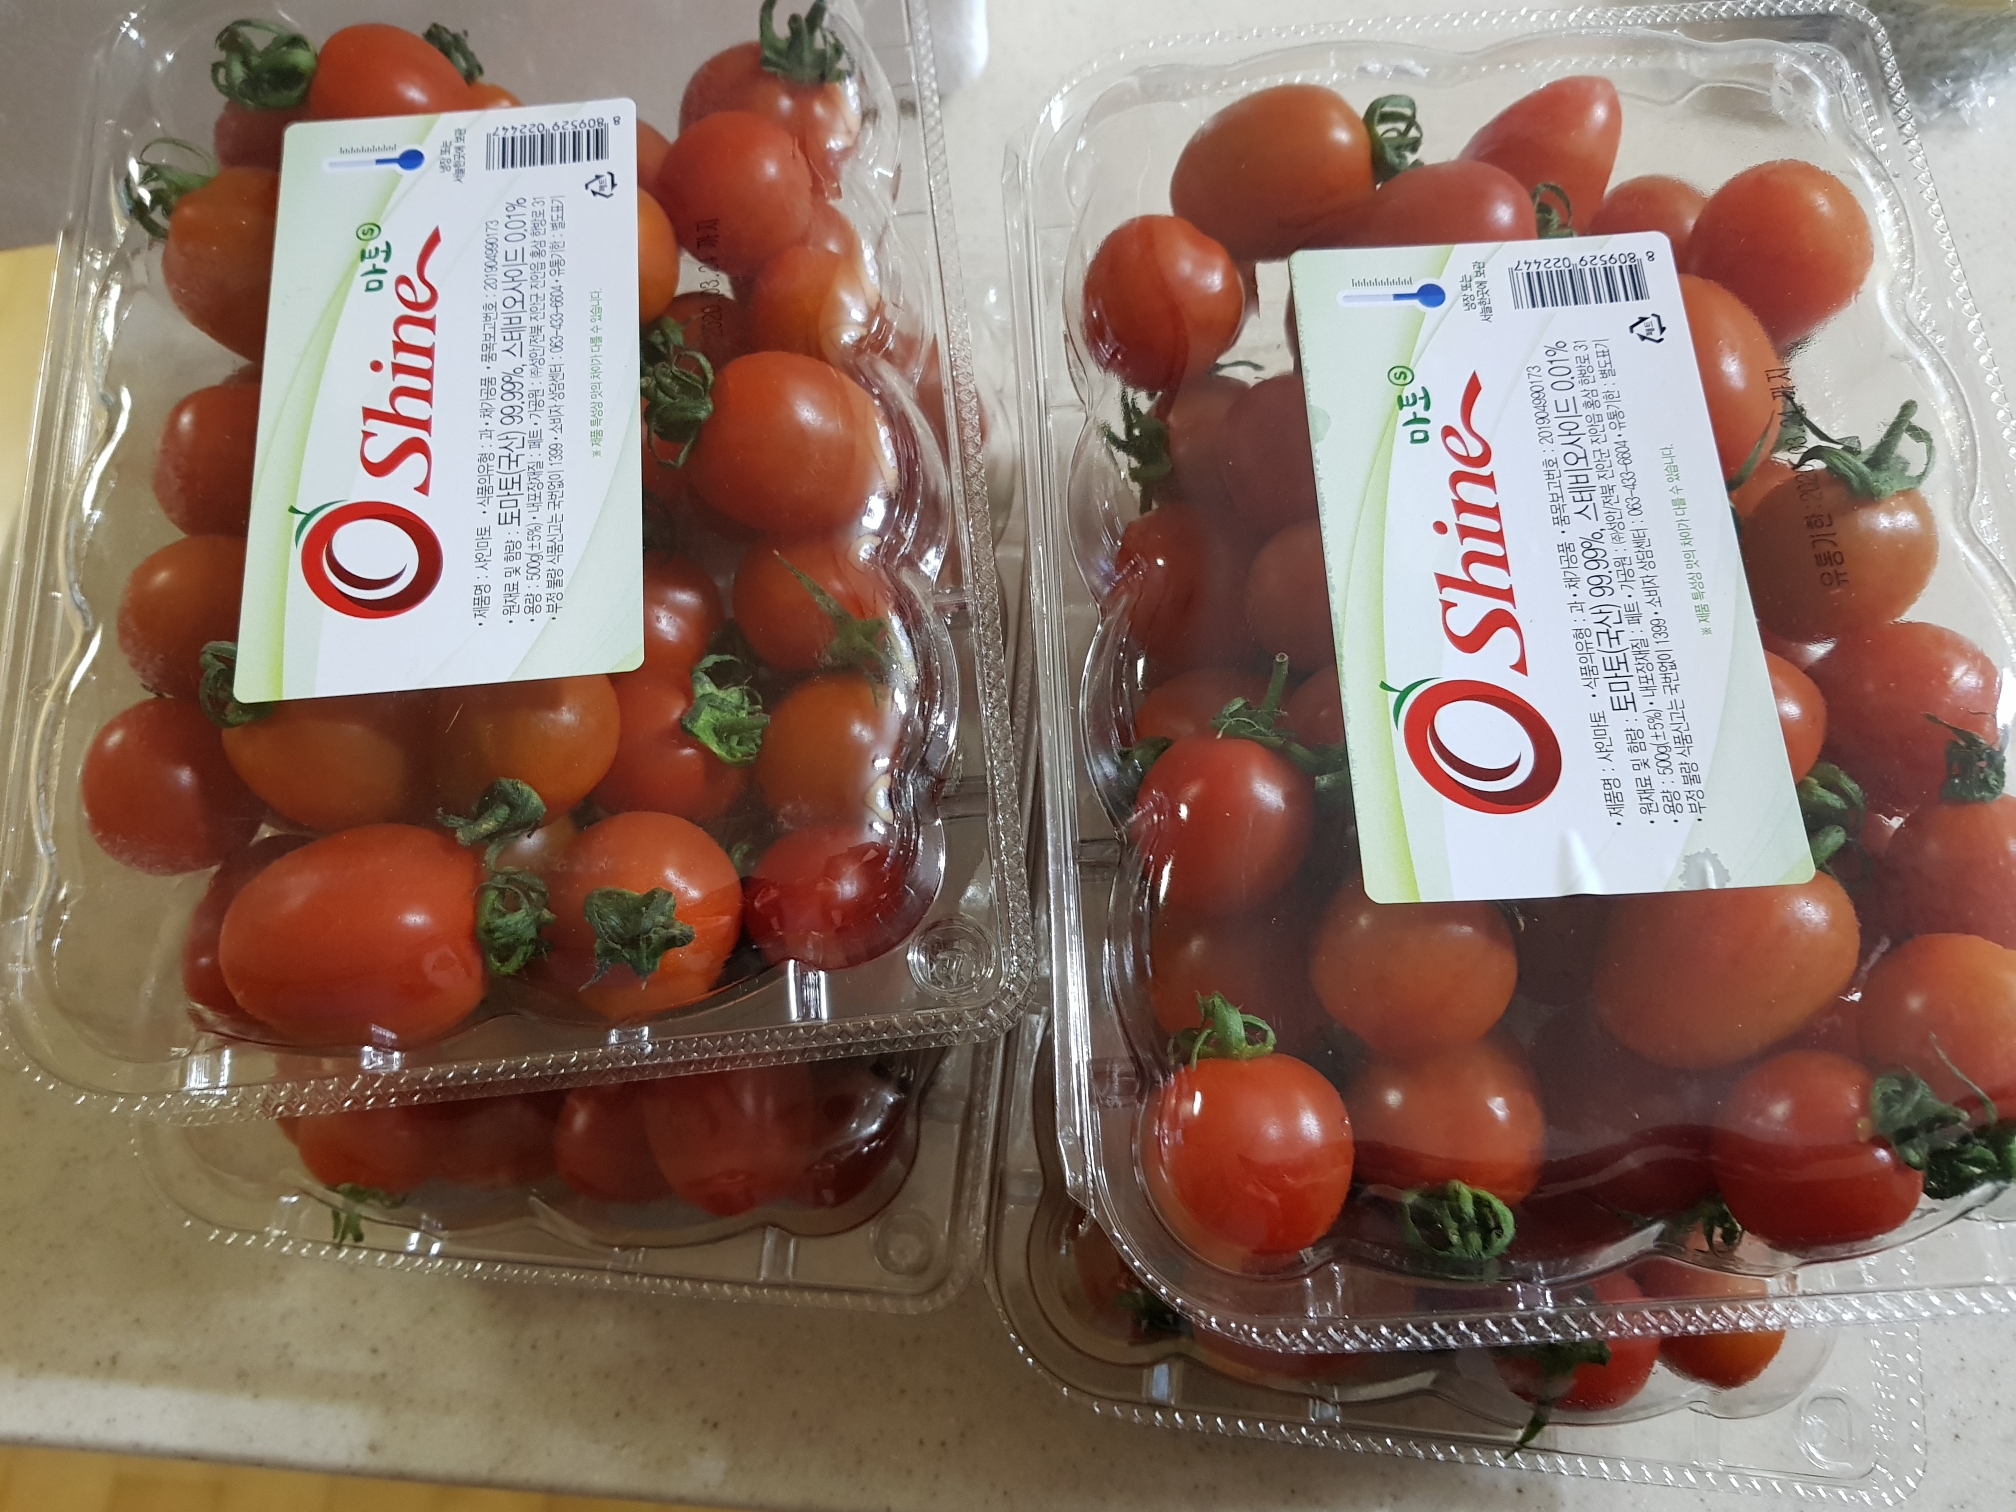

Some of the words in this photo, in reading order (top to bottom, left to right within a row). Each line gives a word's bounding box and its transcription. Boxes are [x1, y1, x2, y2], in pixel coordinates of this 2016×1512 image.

[453, 127, 467, 143] 보관
[491, 122, 545, 137] 022447
[551, 117, 605, 132] 809529
[612, 115, 621, 126] 8
[439, 140, 452, 156] 또는
[438, 157, 452, 173] 냉장
[453, 145, 466, 184] 서늘한곳에
[531, 197, 545, 207] 31
[549, 195, 566, 231] 별도표기
[503, 196, 528, 243] 0.01%
[529, 208, 547, 237] 한방로
[483, 219, 499, 291] 201904990173
[529, 239, 547, 259] 홍삼
[548, 240, 566, 277] 유통기한
[1512, 256, 1572, 271] 022447
[1577, 252, 1638, 267] 809529
[1644, 250, 1656, 262] 8
[359, 240, 392, 292] 마토
[529, 261, 546, 290] 진안읍
[1471, 260, 1486, 278] 보관
[1459, 273, 1473, 292] 또는
[500, 245, 528, 358] 스테비오사이드
[529, 292, 546, 322] 진안군
[1461, 293, 1477, 312] 냉장
[1474, 280, 1493, 323] 서늘한곳에
[480, 300, 498, 363] 품목보고번호
[589, 324, 601, 334] 수
[589, 335, 603, 353] 다를
[1572, 339, 1589, 352] 31
[1591, 338, 1617, 379] 별도표기
[360, 225, 442, 497] Shine
[589, 354, 602, 380] 차이가
[1543, 340, 1575, 392] 0.01%
[1574, 353, 1596, 386] 한방로
[499, 363, 527, 426] 99.99%,
[547, 363, 565, 402] 상담센터
[589, 381, 603, 400] 맛의
[527, 388, 545, 419] 가공원
[589, 400, 603, 427] 특성상
[1396, 384, 1431, 444] 마토
[1525, 364, 1554, 445] 201904990173
[1579, 388, 1601, 410] 홍삼
[1601, 389, 1627, 431] 유통기한
[547, 403, 565, 434] 소비자
[1584, 412, 1608, 445] 진안읍
[525, 428, 544, 450] 페트
[589, 428, 604, 447] 제품
[548, 442, 563, 467] 1399
[1553, 395, 1599, 522] 스테비오사이드
[1591, 447, 1615, 481] 진안군
[475, 451, 497, 507] 식품의유형
[495, 430, 526, 527] 토마토(국산)
[525, 460, 544, 513] 내포장재질
[546, 469, 564, 511] 국번없이
[1541, 456, 1571, 527] 품목보고번호
[1668, 485, 1684, 495] 수
[1670, 497, 1687, 517] 다를
[545, 512, 564, 565] 식품신고는
[1432, 370, 1528, 677] Shine
[1674, 518, 1694, 547] 차이가
[473, 524, 492, 571] 샤인마토
[503, 539, 522, 563] 함량
[1578, 527, 1615, 598] 99.99%,
[1628, 527, 1657, 572] 상담센터
[1681, 549, 1700, 570] 맛의
[503, 565, 521, 578] 및
[545, 567, 564, 590] 불량
[1611, 556, 1636, 591] 가공원
[1686, 571, 1705, 601] 특성상
[472, 583, 492, 619] 제품명
[501, 580, 520, 616] 원재료
[523, 592, 543, 616] 용량
[545, 591, 564, 614] 부정
[1638, 574, 1663, 608] 소비자
[1622, 600, 1643, 625] 페트
[1693, 603, 1710, 623] 제품
[1649, 618, 1670, 645] 1399
[1571, 627, 1600, 690] 식품의유형
[1587, 603, 1638, 713] 토마토(국산)
[1628, 637, 1658, 698] 내포장재질
[1654, 648, 1681, 696] 국번없이
[1588, 709, 1615, 763] 샤인마토
[1623, 727, 1647, 754] 함량
[1666, 698, 1694, 758] 식품신고는
[1629, 757, 1651, 771] 및
[1677, 761, 1702, 786] 불량
[1599, 777, 1625, 817] 제품명
[1634, 774, 1660, 816] 원재료
[1659, 789, 1684, 816] 용량
[1683, 789, 1707, 814] 부정
